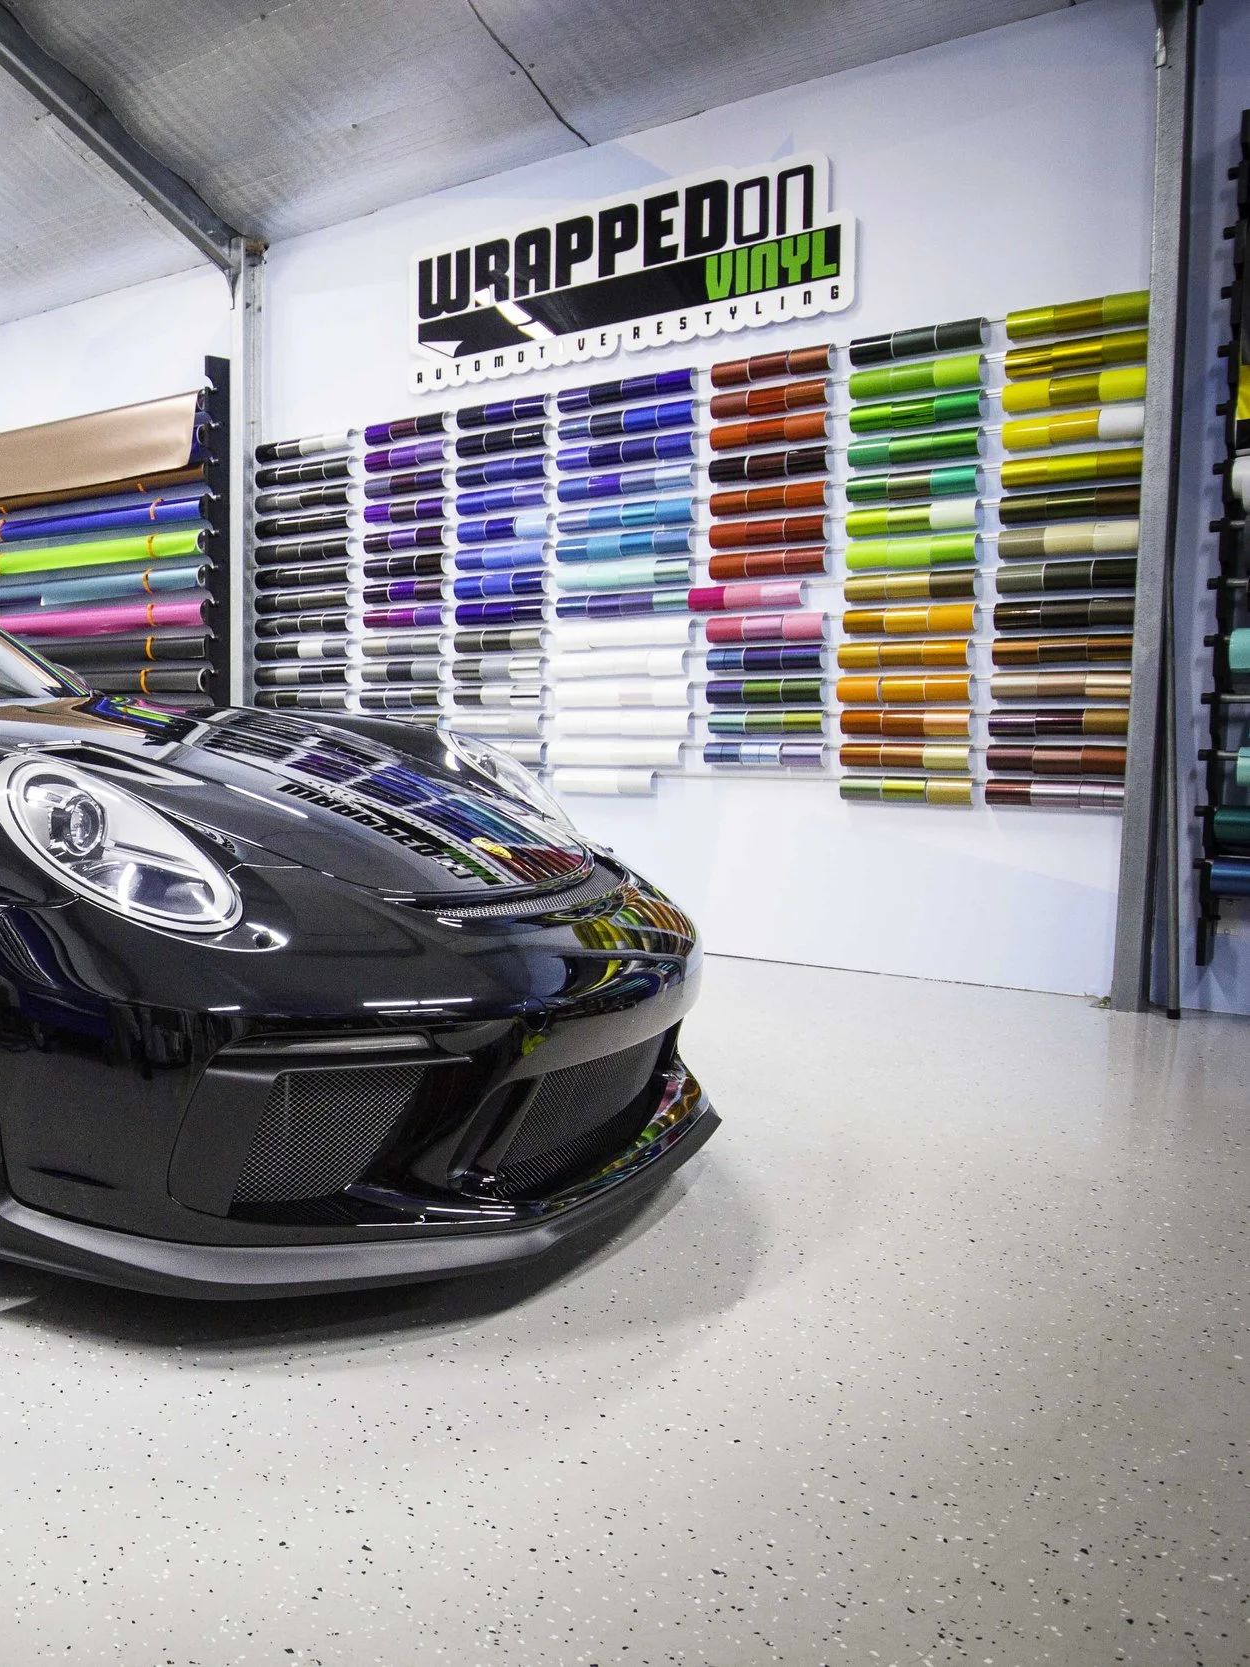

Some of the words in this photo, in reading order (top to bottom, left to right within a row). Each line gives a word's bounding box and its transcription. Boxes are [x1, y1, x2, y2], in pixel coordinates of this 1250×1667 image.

[418, 179, 729, 320] WRAPPED
[706, 229, 838, 301] VINYL
[632, 284, 840, 340] RESTYLING
